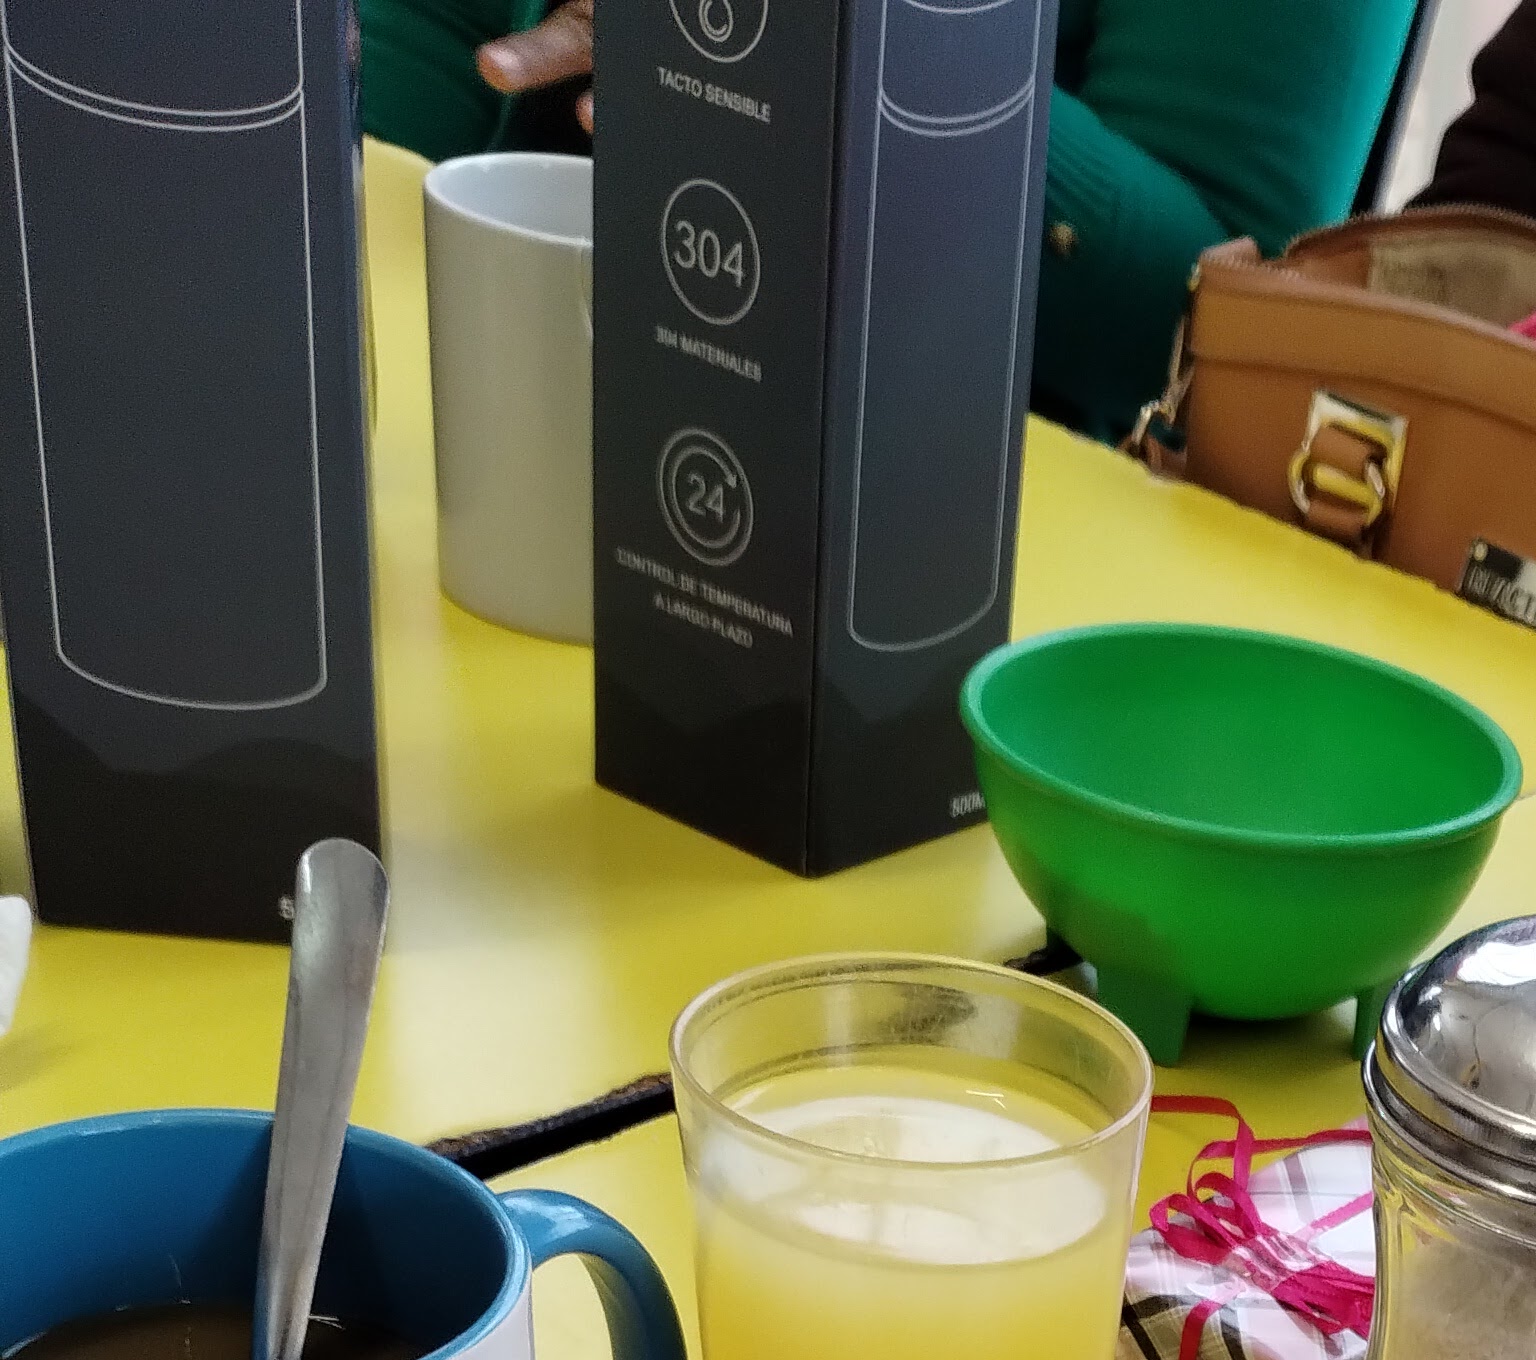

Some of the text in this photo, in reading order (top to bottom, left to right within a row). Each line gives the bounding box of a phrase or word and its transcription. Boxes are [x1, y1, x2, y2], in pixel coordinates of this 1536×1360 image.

[656, 65, 771, 124] TACTO SENSIBLE
[674, 220, 745, 287] 304
[686, 472, 725, 523] 24
